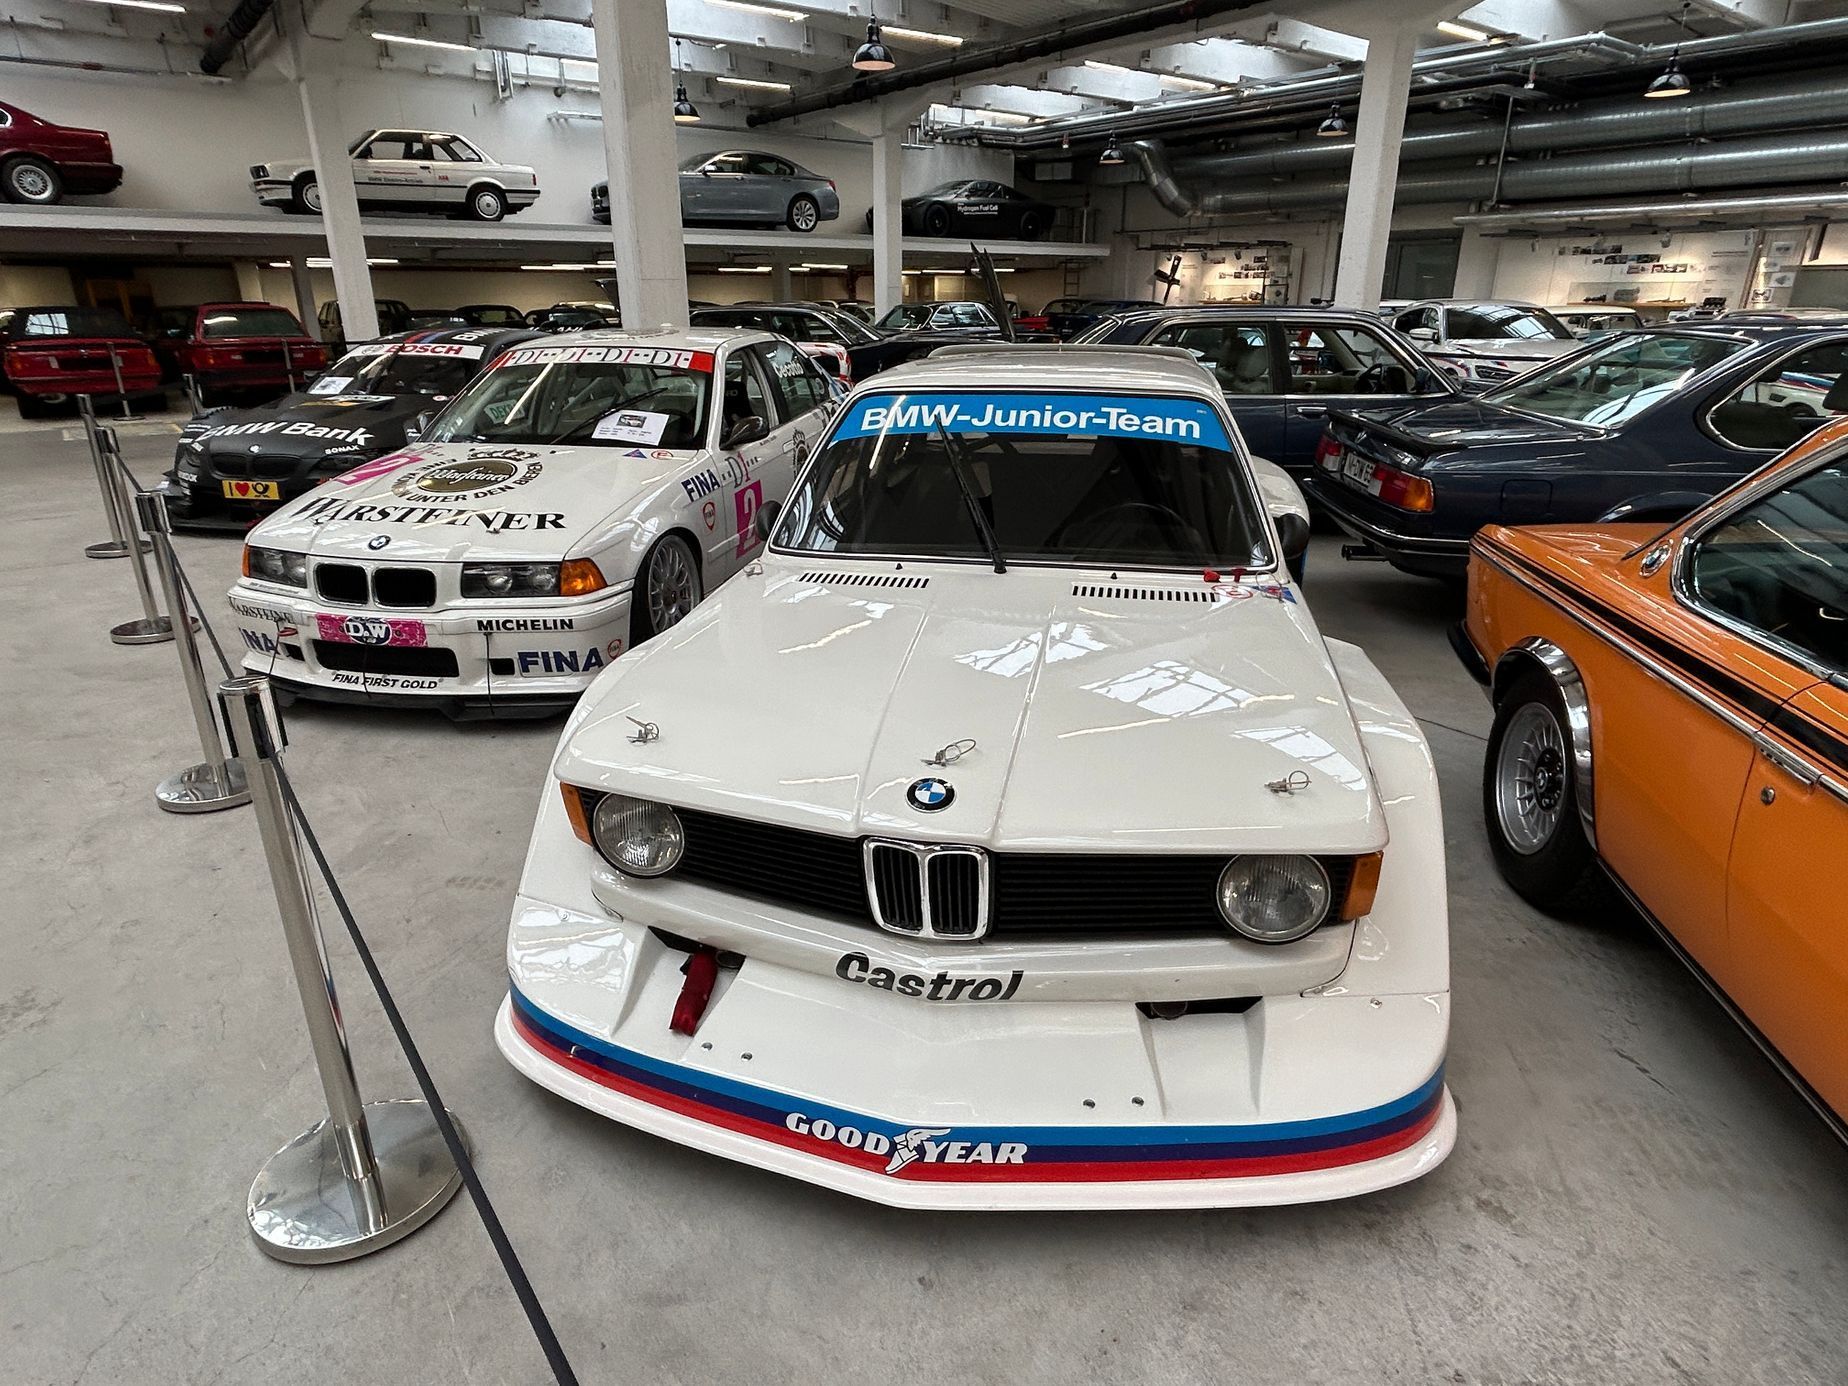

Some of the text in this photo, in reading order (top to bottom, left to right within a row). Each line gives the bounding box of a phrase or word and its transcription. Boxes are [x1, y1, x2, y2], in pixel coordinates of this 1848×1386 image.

[195, 421, 374, 446] BMW Bank
[861, 404, 1200, 438] BMW-Junior-Team
[324, 445, 360, 454] SONAX
[405, 494, 467, 503] UNTER
[473, 485, 515, 499] DEN
[681, 469, 720, 502] FINA
[290, 497, 567, 532] WARSTEINER
[477, 619, 574, 631] MICHELIN
[518, 647, 604, 673] FINA
[332, 674, 437, 689] FINA FIRST GOLD
[835, 951, 1024, 1001] Castrol
